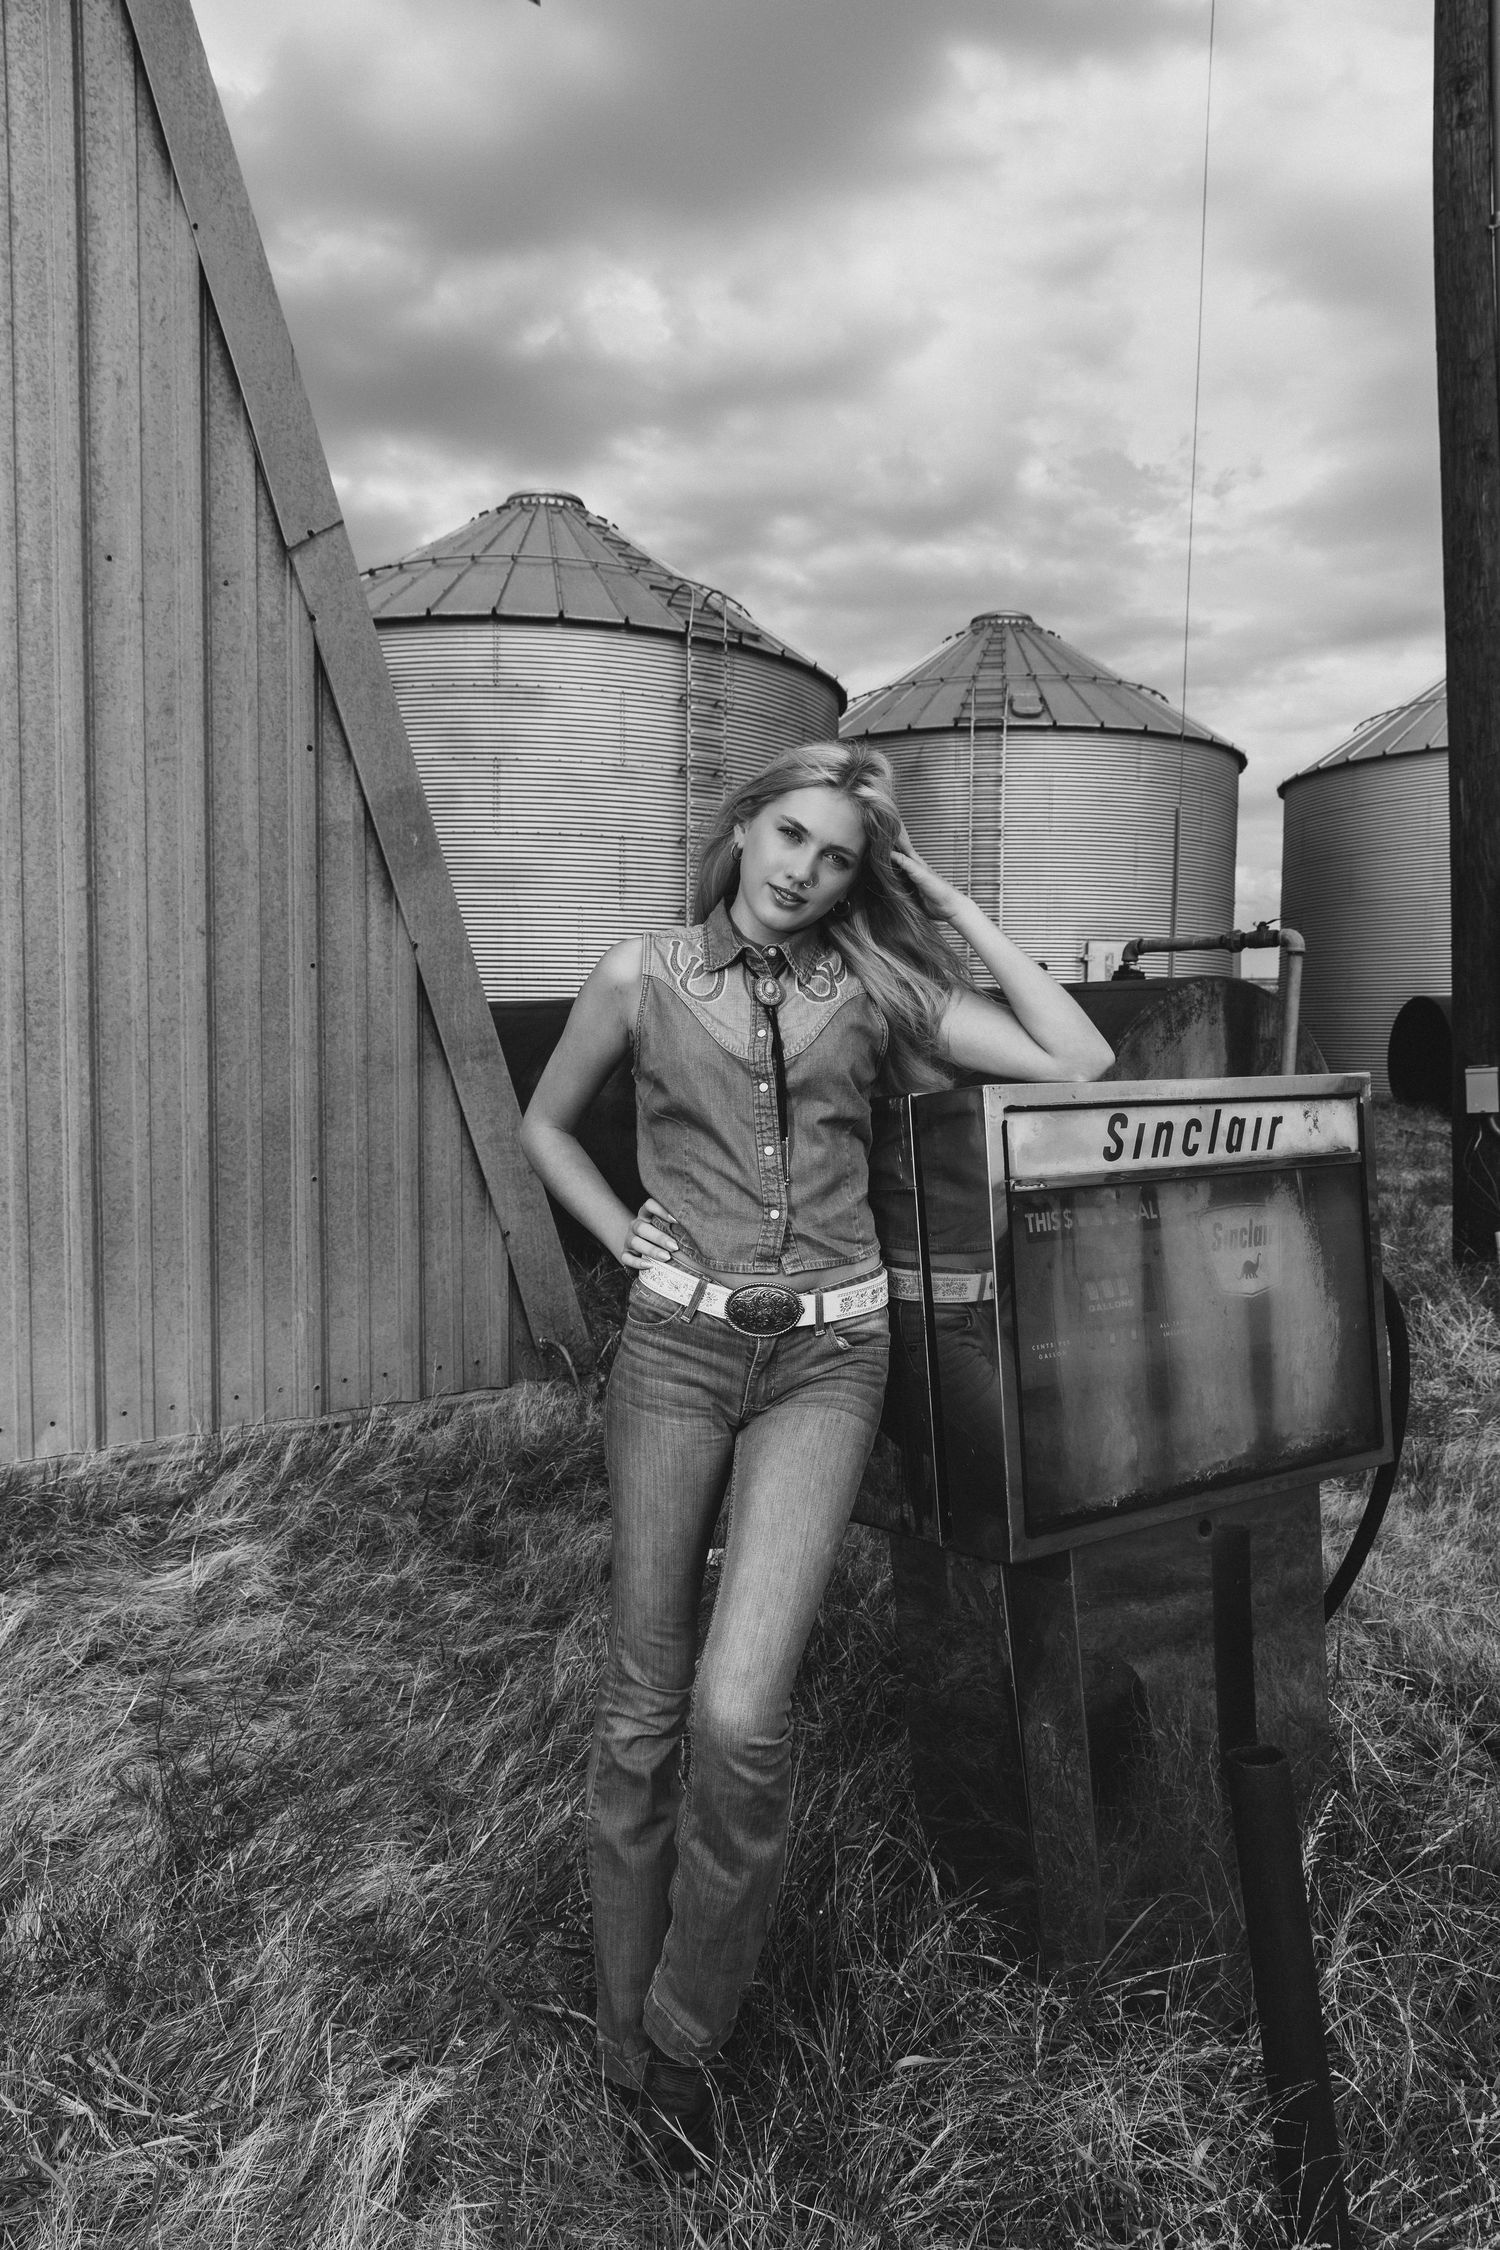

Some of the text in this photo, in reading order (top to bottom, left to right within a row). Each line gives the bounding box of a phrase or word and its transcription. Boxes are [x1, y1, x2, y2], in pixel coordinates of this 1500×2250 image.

[1102, 1108, 1283, 1162] Sinclair
[1024, 1210, 1061, 1234] THIS
[1063, 1208, 1074, 1231] $
